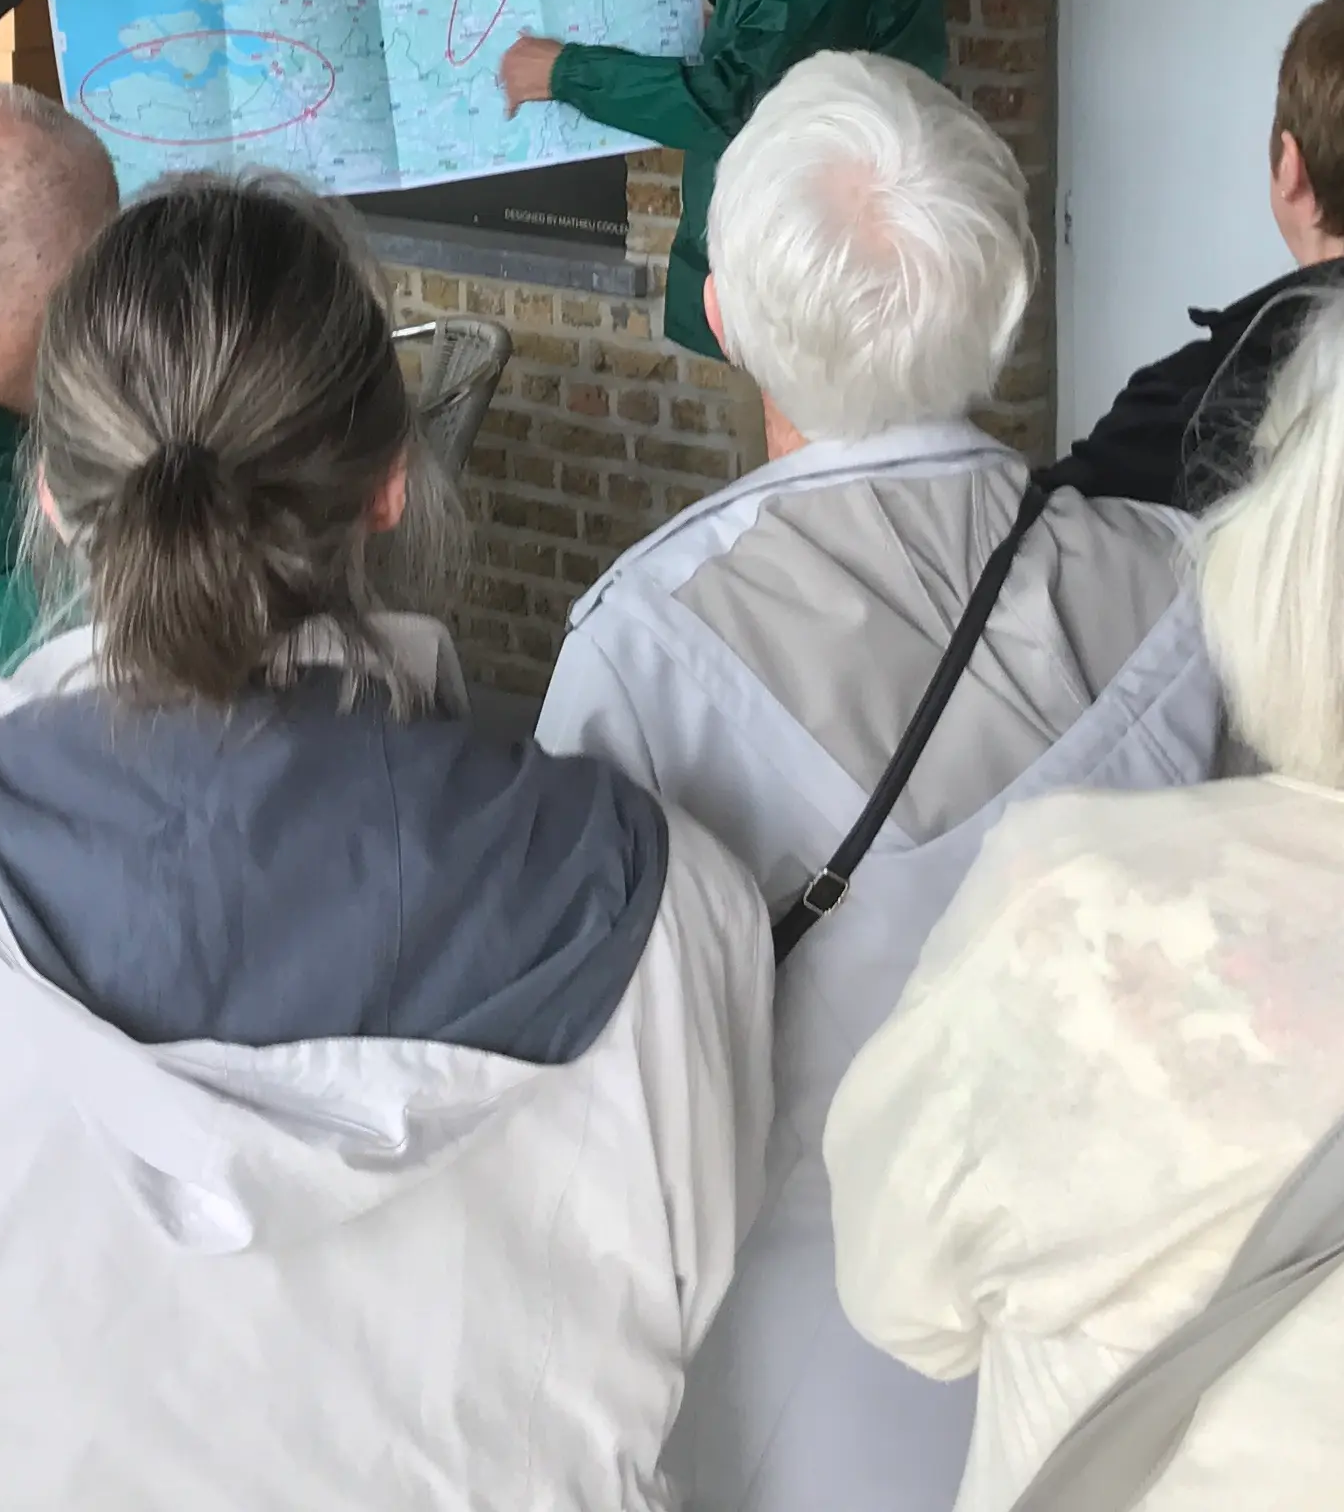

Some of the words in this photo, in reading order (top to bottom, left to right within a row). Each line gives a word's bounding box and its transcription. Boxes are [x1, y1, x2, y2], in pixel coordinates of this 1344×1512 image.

[504, 208, 545, 224] DESIGNED
[546, 215, 558, 226] BY
[558, 217, 595, 231] MATHIEU
